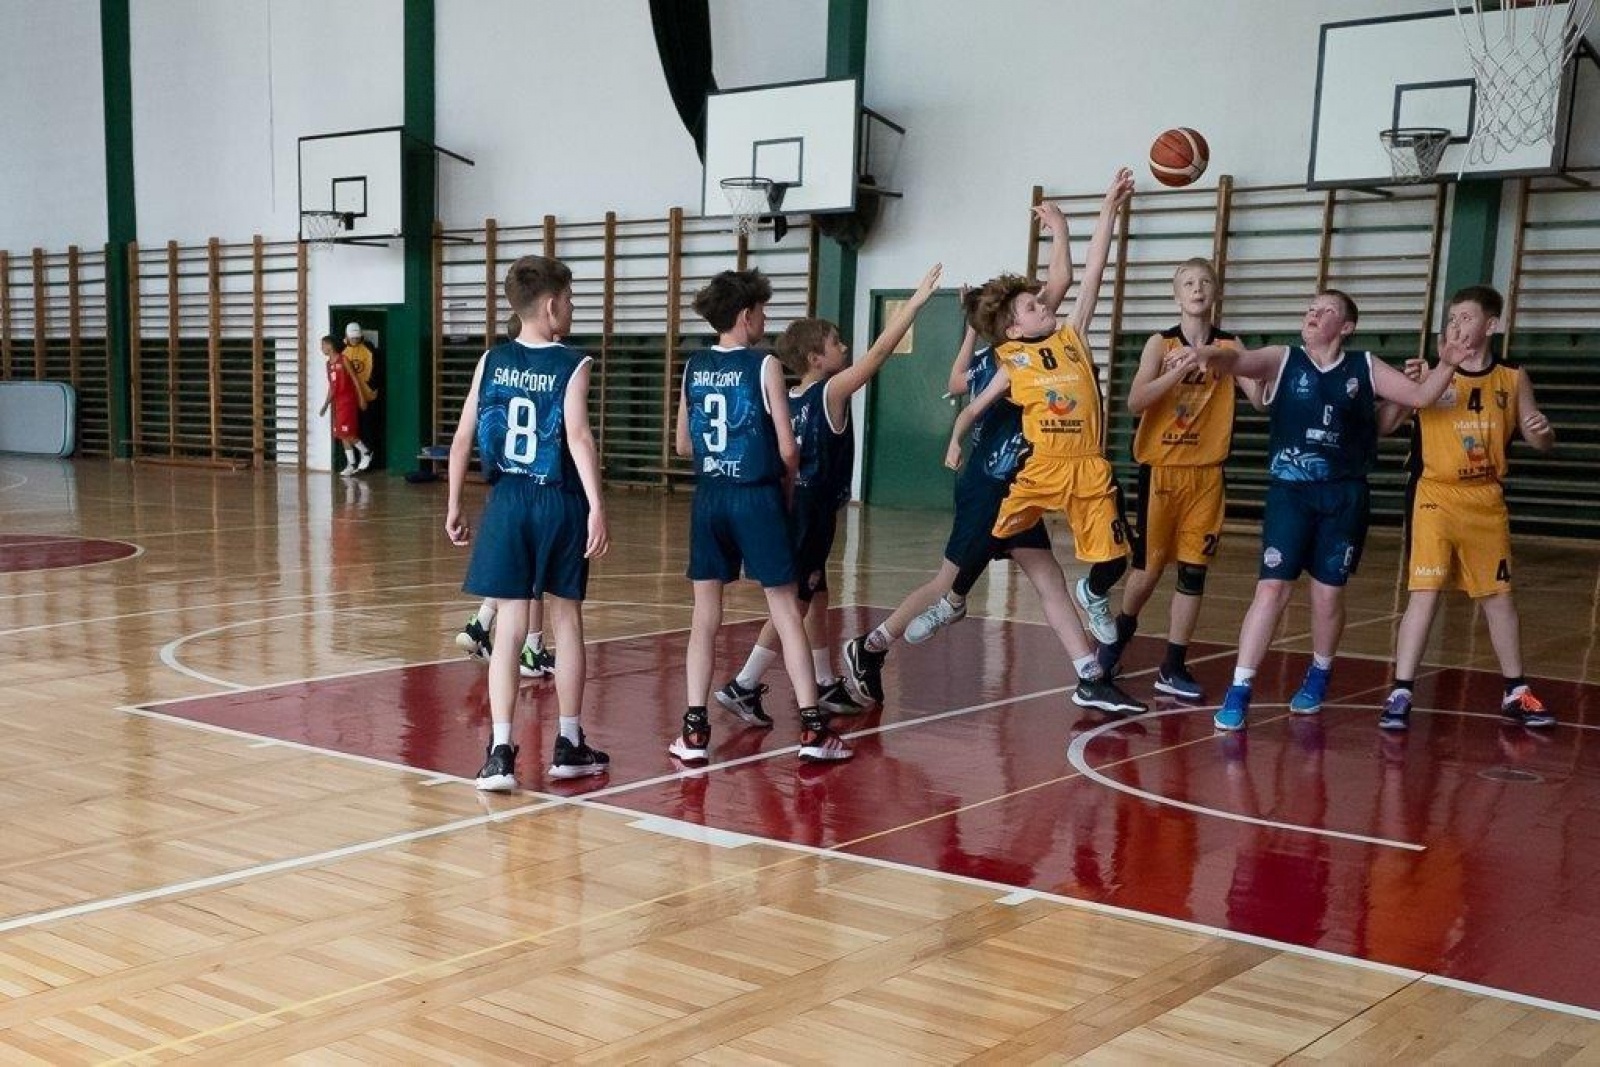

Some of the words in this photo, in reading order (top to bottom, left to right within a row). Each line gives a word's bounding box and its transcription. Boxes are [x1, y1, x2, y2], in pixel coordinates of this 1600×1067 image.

[1039, 347, 1058, 370] 8
[1467, 387, 1484, 414] 4
[703, 393, 727, 452] 3
[1322, 404, 1334, 426] 6
[504, 396, 537, 464] 8
[1111, 519, 1124, 545] 8
[1496, 559, 1511, 583] 4
